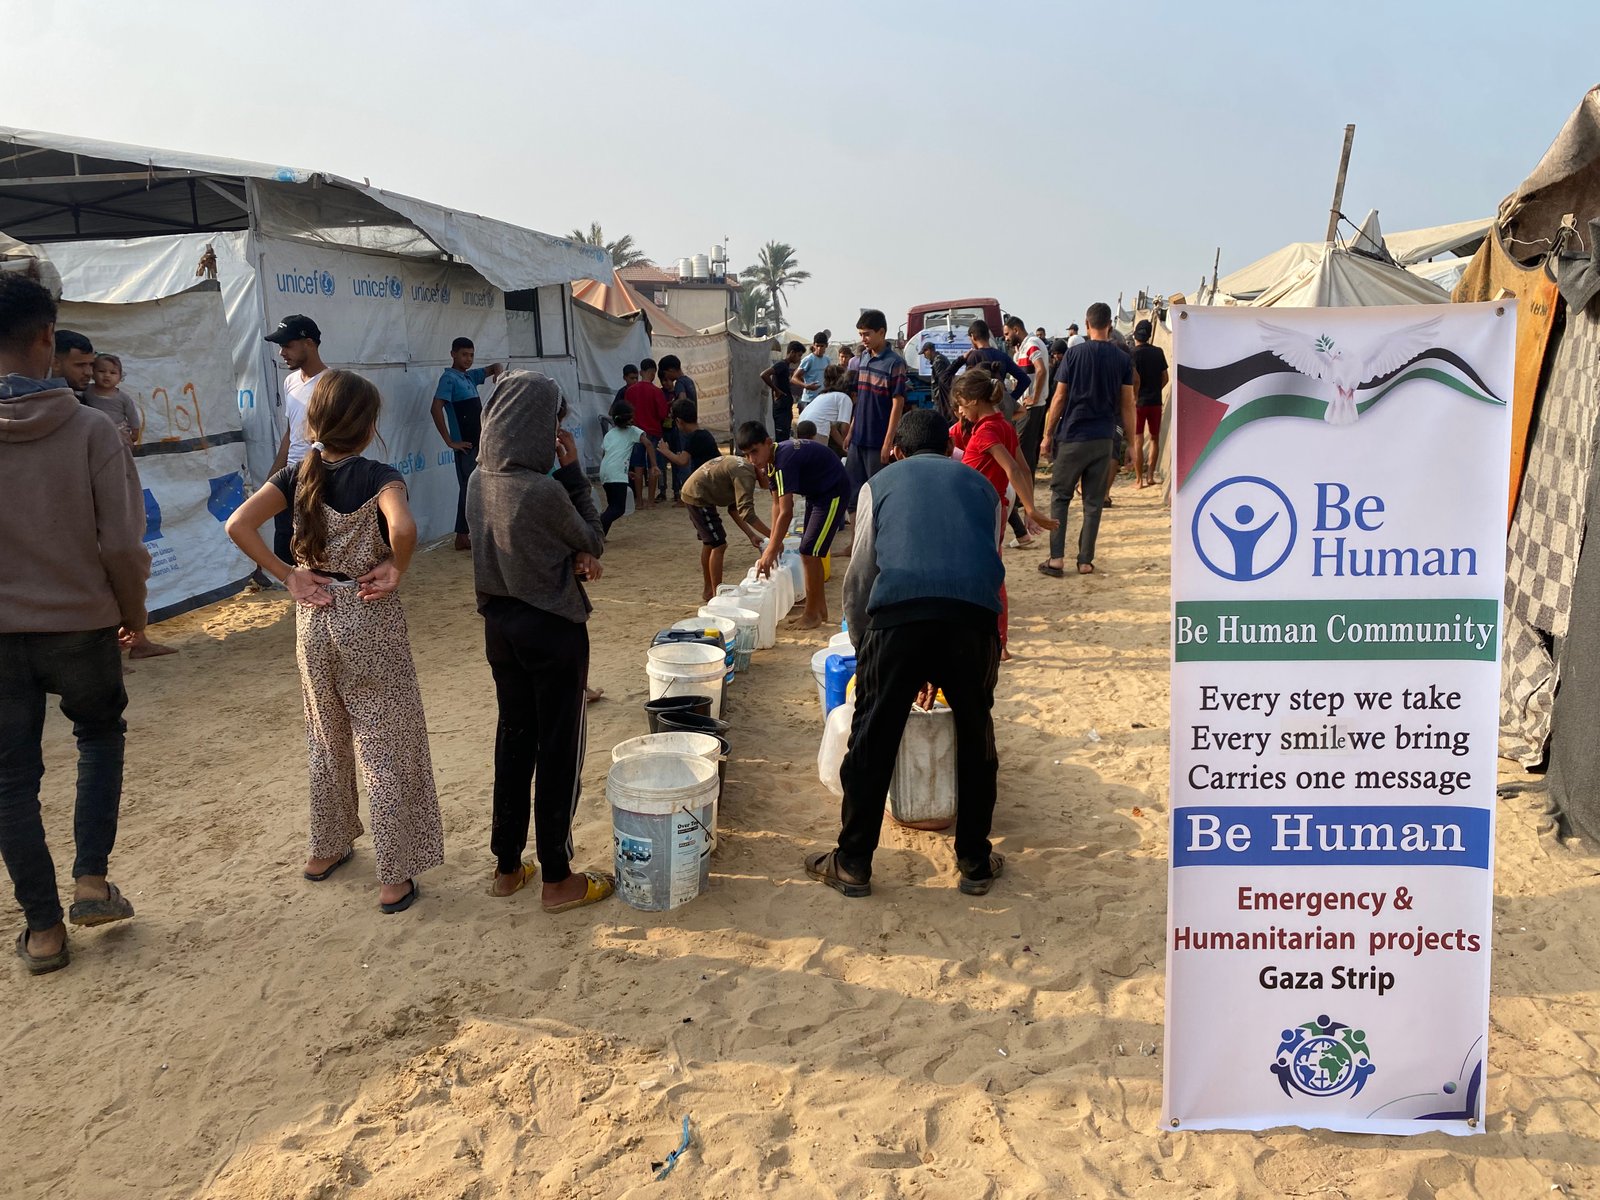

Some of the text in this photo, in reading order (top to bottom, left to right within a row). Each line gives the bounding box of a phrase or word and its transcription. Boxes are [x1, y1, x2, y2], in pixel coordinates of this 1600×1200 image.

[276, 268, 319, 295] unicef
[353, 274, 389, 297] unicef
[411, 281, 440, 303] unicef
[462, 287, 487, 307] unicef
[1312, 482, 1385, 531] Be
[1312, 537, 1478, 577] Human
[1177, 614, 1494, 650] Be Human Community
[1200, 684, 1461, 716] Every step we take
[1191, 724, 1470, 756] Every smile we bring
[1188, 764, 1472, 795] Carries one message
[1186, 814, 1466, 852] Be Human
[1238, 886, 1413, 916] Emergency &
[1174, 925, 1481, 956] Humanitarian projects
[1259, 965, 1395, 996] Gaza Strip
